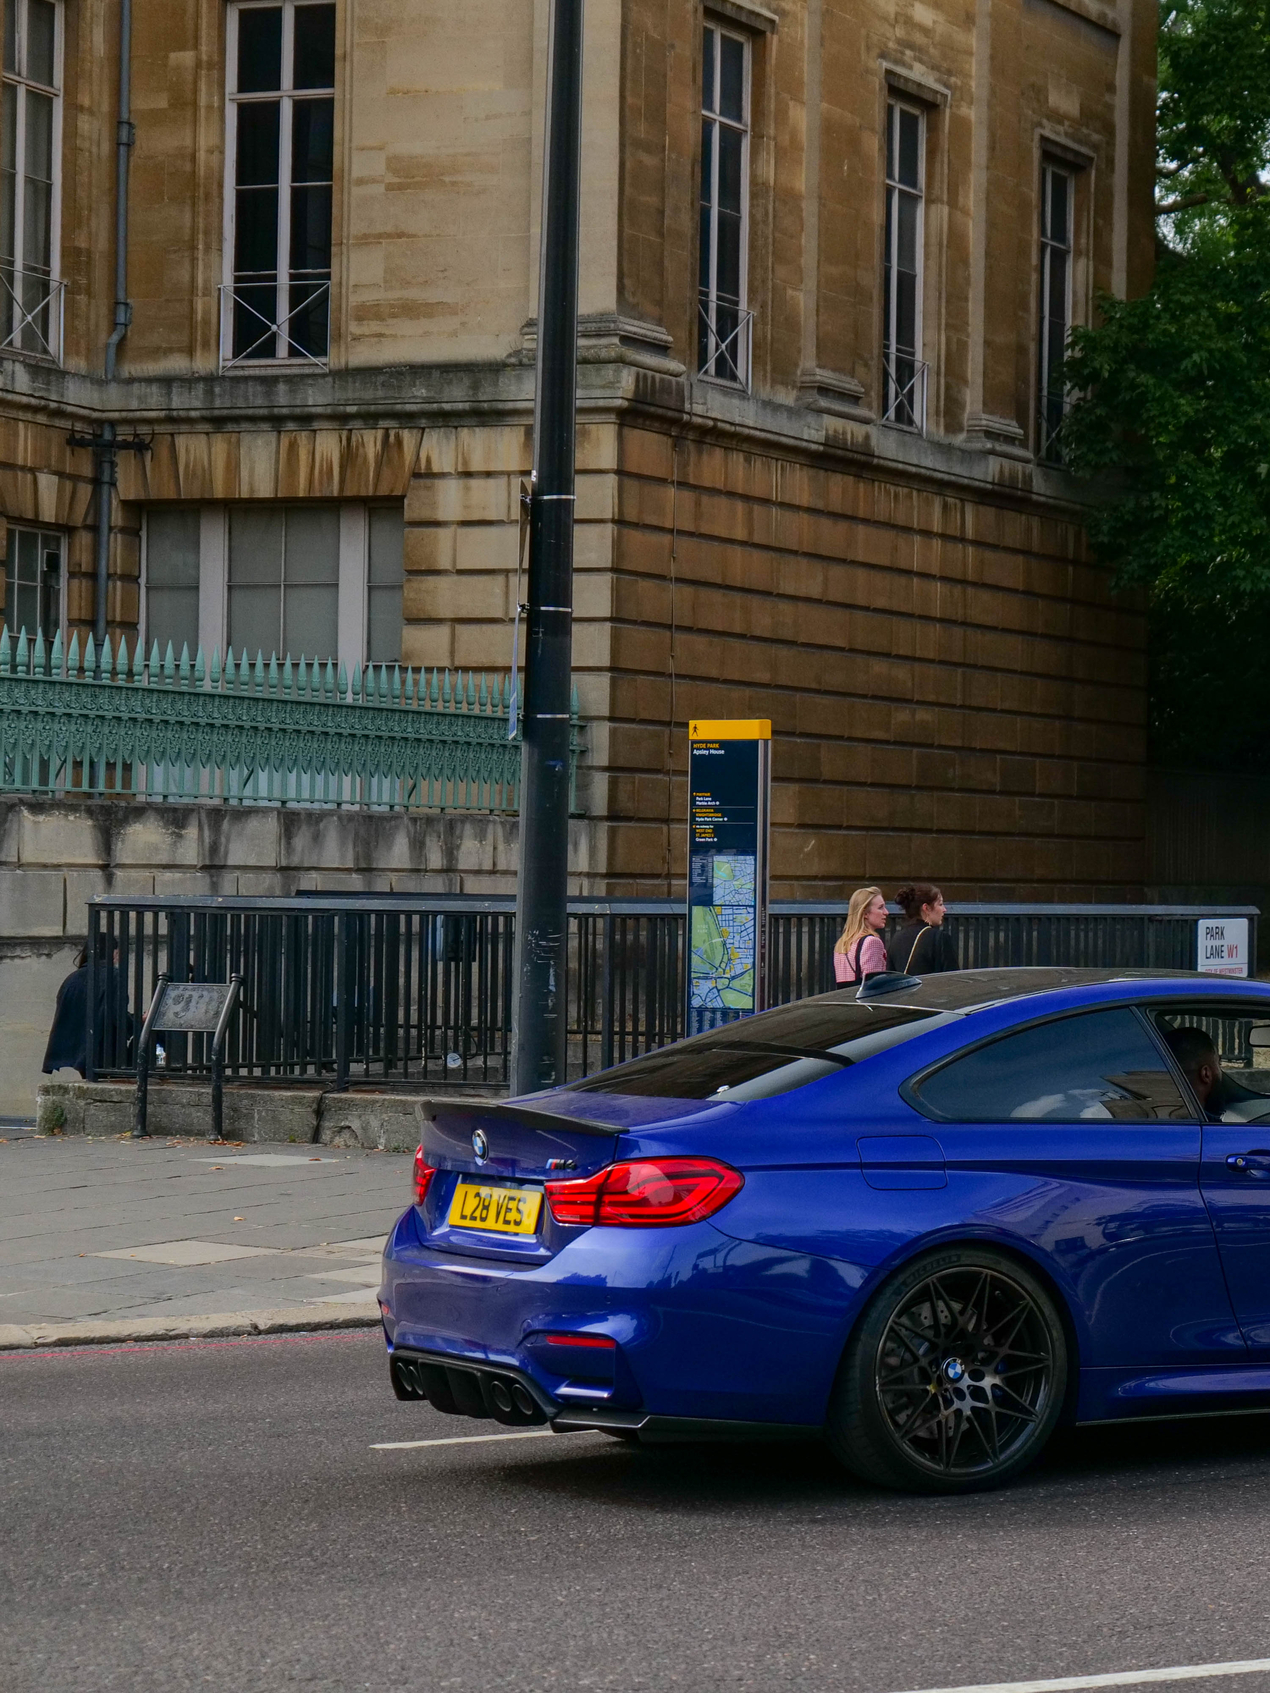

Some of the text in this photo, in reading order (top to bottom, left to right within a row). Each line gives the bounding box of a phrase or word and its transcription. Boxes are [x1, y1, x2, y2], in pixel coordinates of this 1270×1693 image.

[1206, 926, 1225, 940] PARK
[1206, 944, 1238, 959] LANE W1
[460, 1190, 526, 1226] L28 VES
